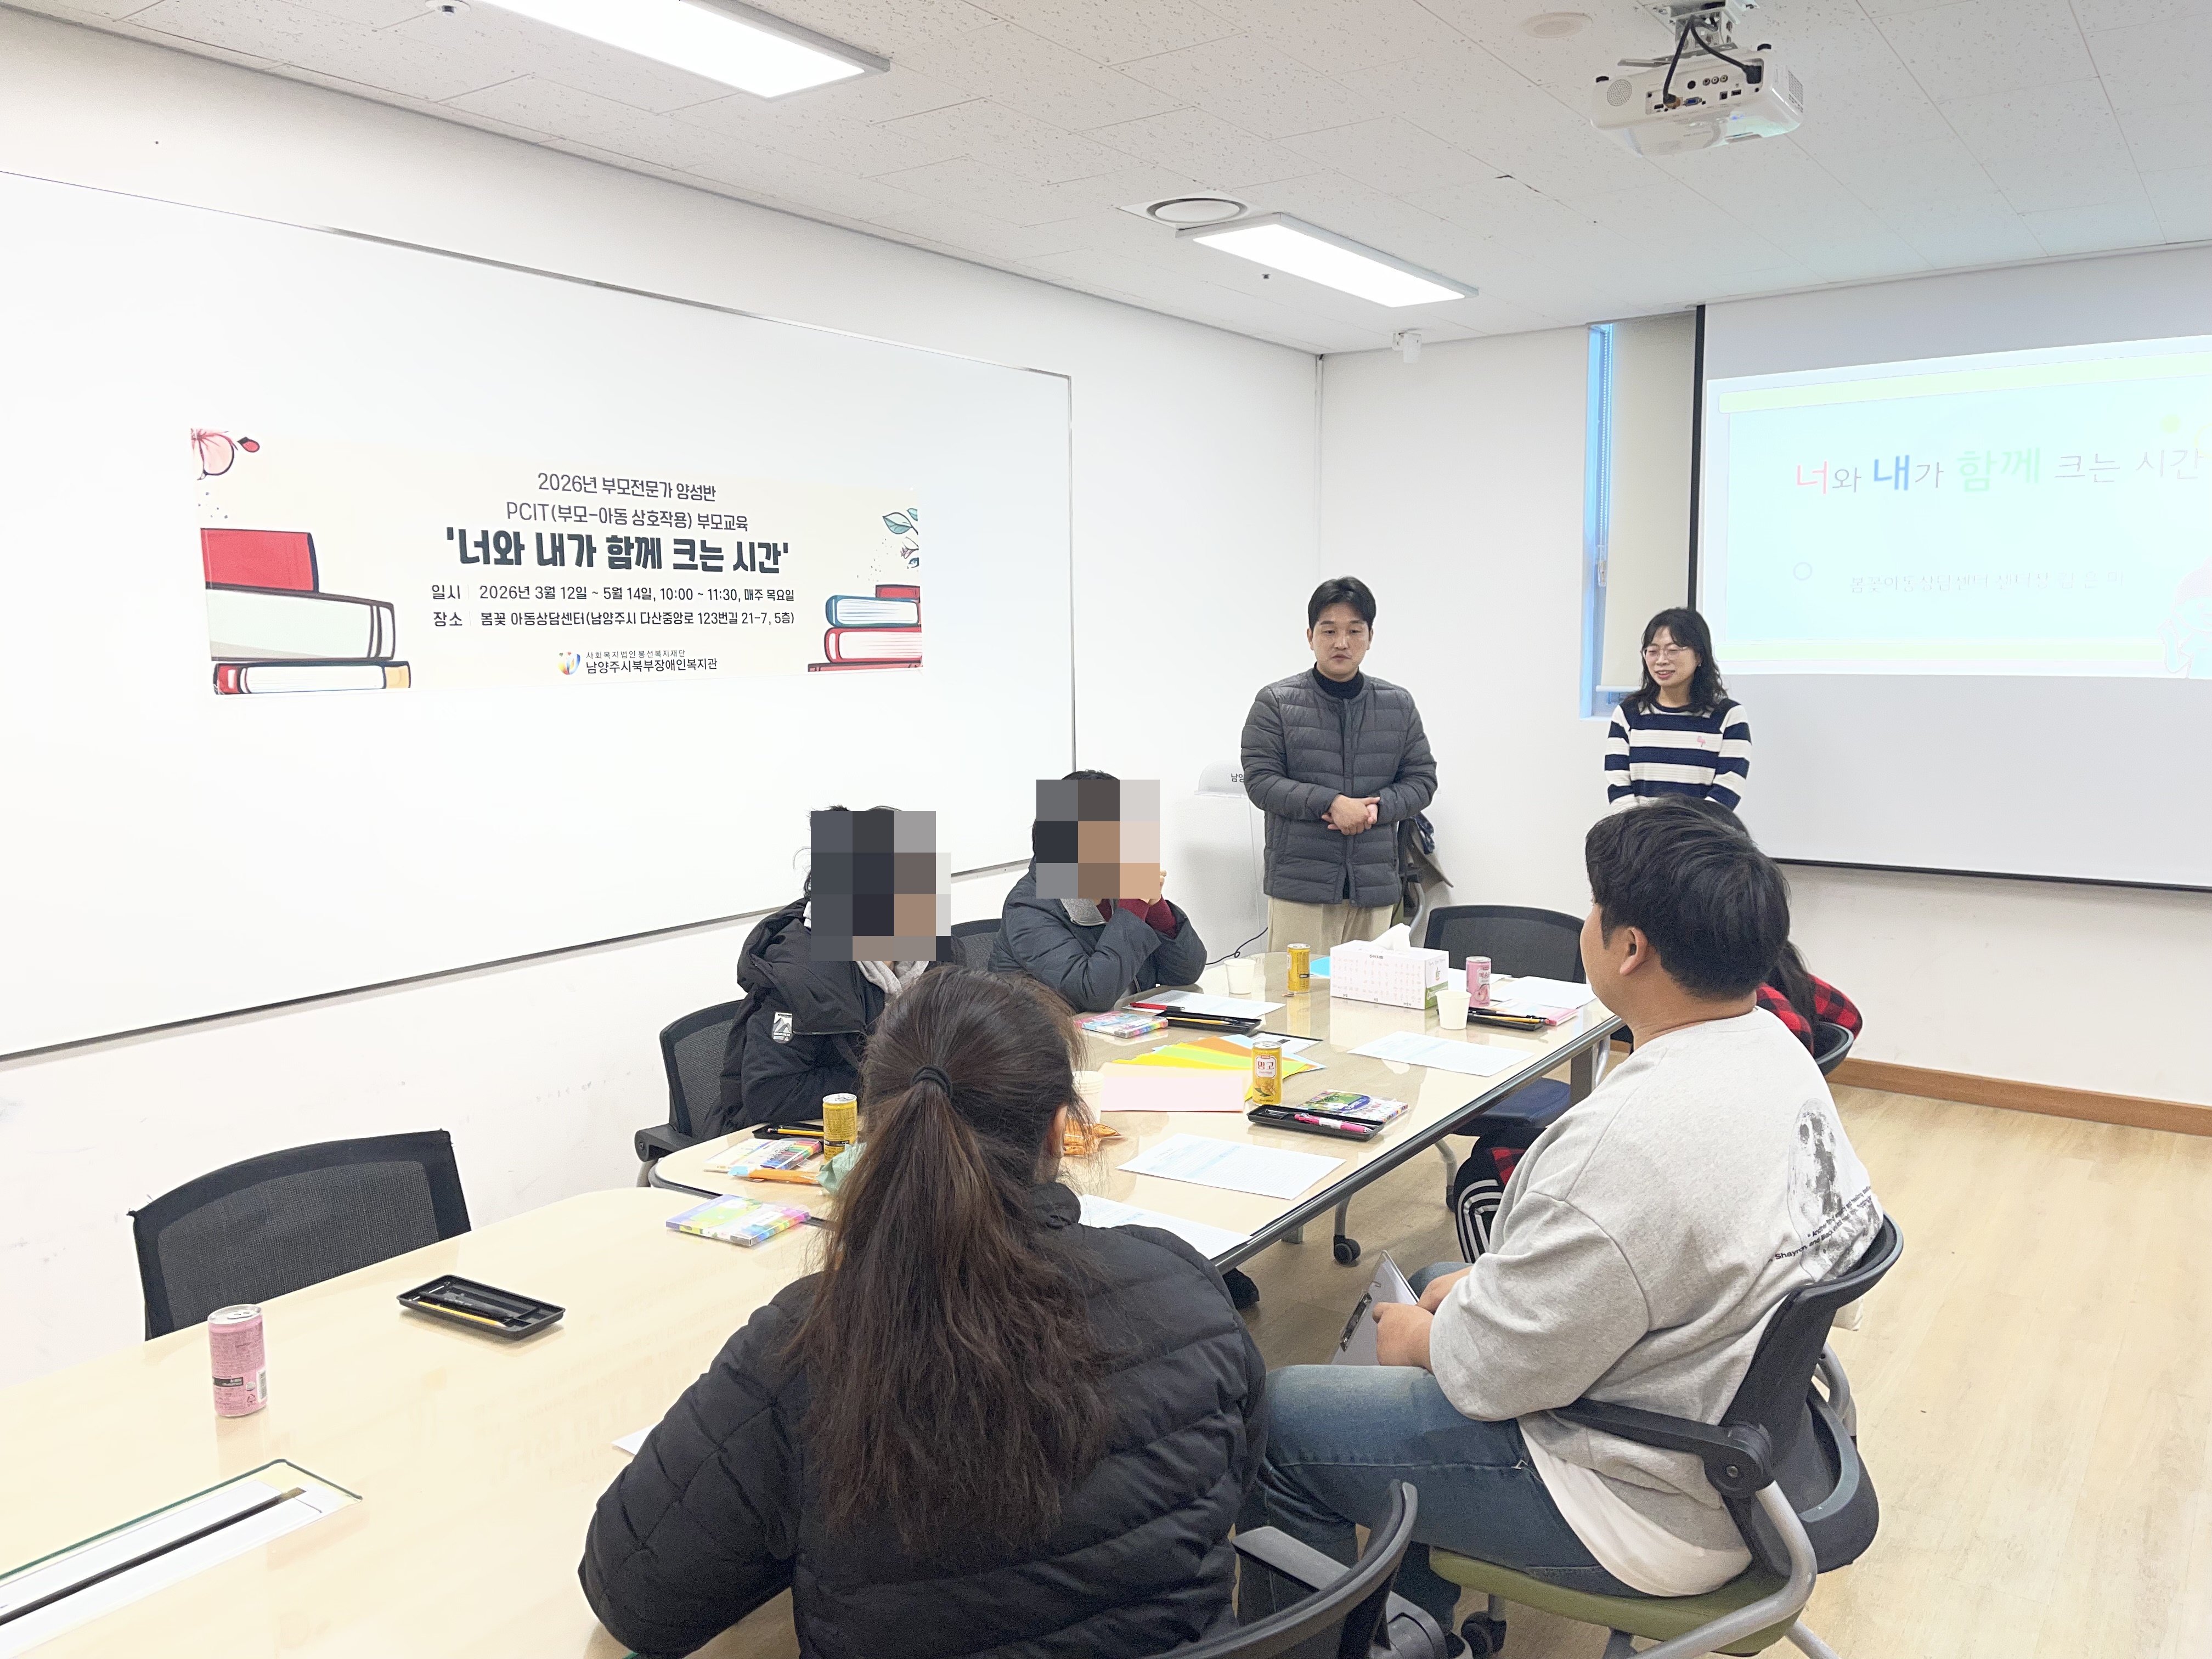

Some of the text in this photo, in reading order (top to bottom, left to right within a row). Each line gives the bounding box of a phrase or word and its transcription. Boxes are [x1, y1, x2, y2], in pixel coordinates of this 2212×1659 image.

[1795, 447, 2203, 496] 너와 내가 함께 크는 시간
[538, 472, 716, 502] 2026년 부모전문가 양성반
[506, 501, 748, 532] PCIT(부모-아동 상호작용) 부모교육
[446, 527, 788, 574] '너와 내가 함께 크는 시간'
[431, 584, 460, 600] 일시
[479, 585, 530, 599] 2026년
[535, 586, 556, 600] 3월
[560, 586, 587, 600] 12일
[603, 586, 623, 600] 5월
[627, 587, 656, 602] 14일,
[659, 588, 693, 600] 10:00
[707, 589, 741, 603] 11:30,
[744, 589, 764, 601] 매주
[766, 589, 794, 601] 목요일
[433, 612, 794, 627] 장소 봄꽃 아동상담센터(남양주시 다산중앙로 123번길 21-7, 5층)
[586, 650, 685, 659] 사회복지법인 봉선복지재단
[586, 658, 718, 674] 남양주시북부장애인복지관
[1257, 1060, 1274, 1070] 망고
